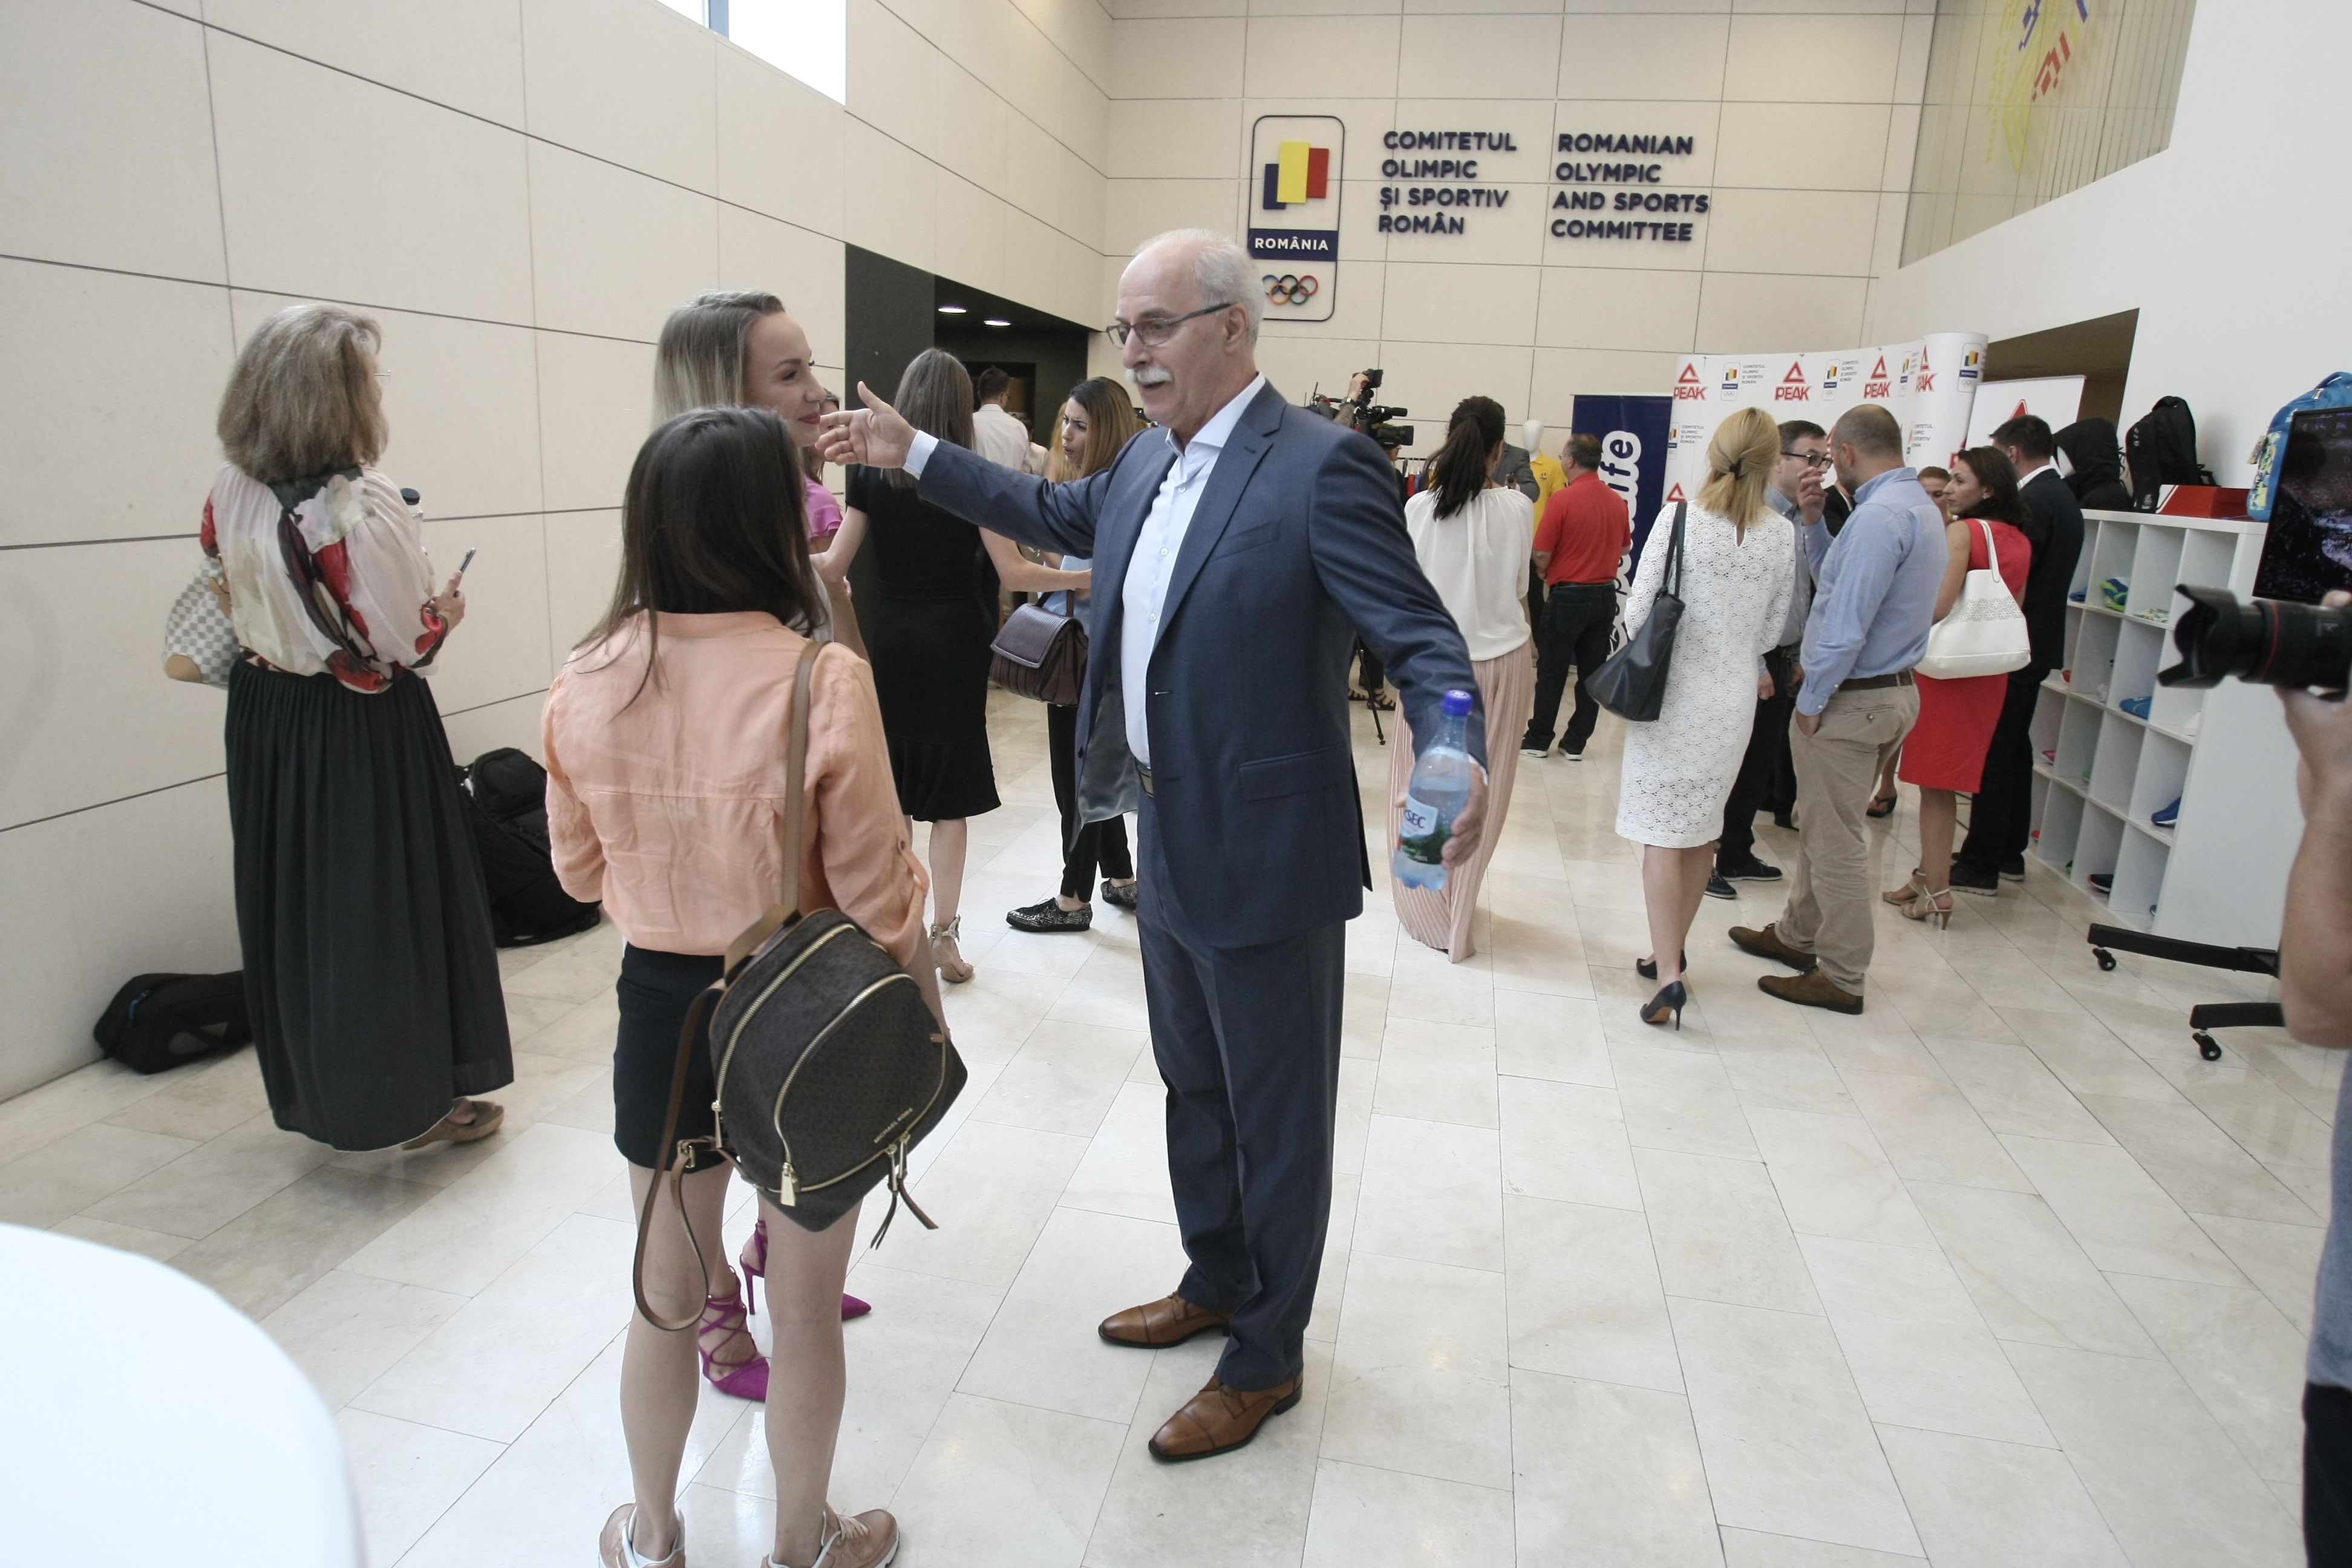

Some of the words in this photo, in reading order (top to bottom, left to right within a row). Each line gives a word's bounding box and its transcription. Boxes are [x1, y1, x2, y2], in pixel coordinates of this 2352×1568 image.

[1383, 130, 1518, 151] COMITETUL
[1557, 132, 1694, 155] ROMANIAN
[1381, 159, 1478, 179] OLIMPIC
[1555, 162, 1662, 183] OLYMPIC
[1379, 187, 1400, 211] ȘI
[1408, 188, 1510, 208] SPORTIV
[1552, 191, 1606, 211] AND
[1613, 192, 1710, 214] SPORTS
[1378, 211, 1465, 235] ROMÂN
[1550, 218, 1694, 242] COMMITTEE
[1255, 236, 1329, 250] ROMÂNIA
[1673, 386, 1708, 400] PEAK
[1774, 386, 1812, 400] PEAK
[1864, 381, 1892, 398] PEAK
